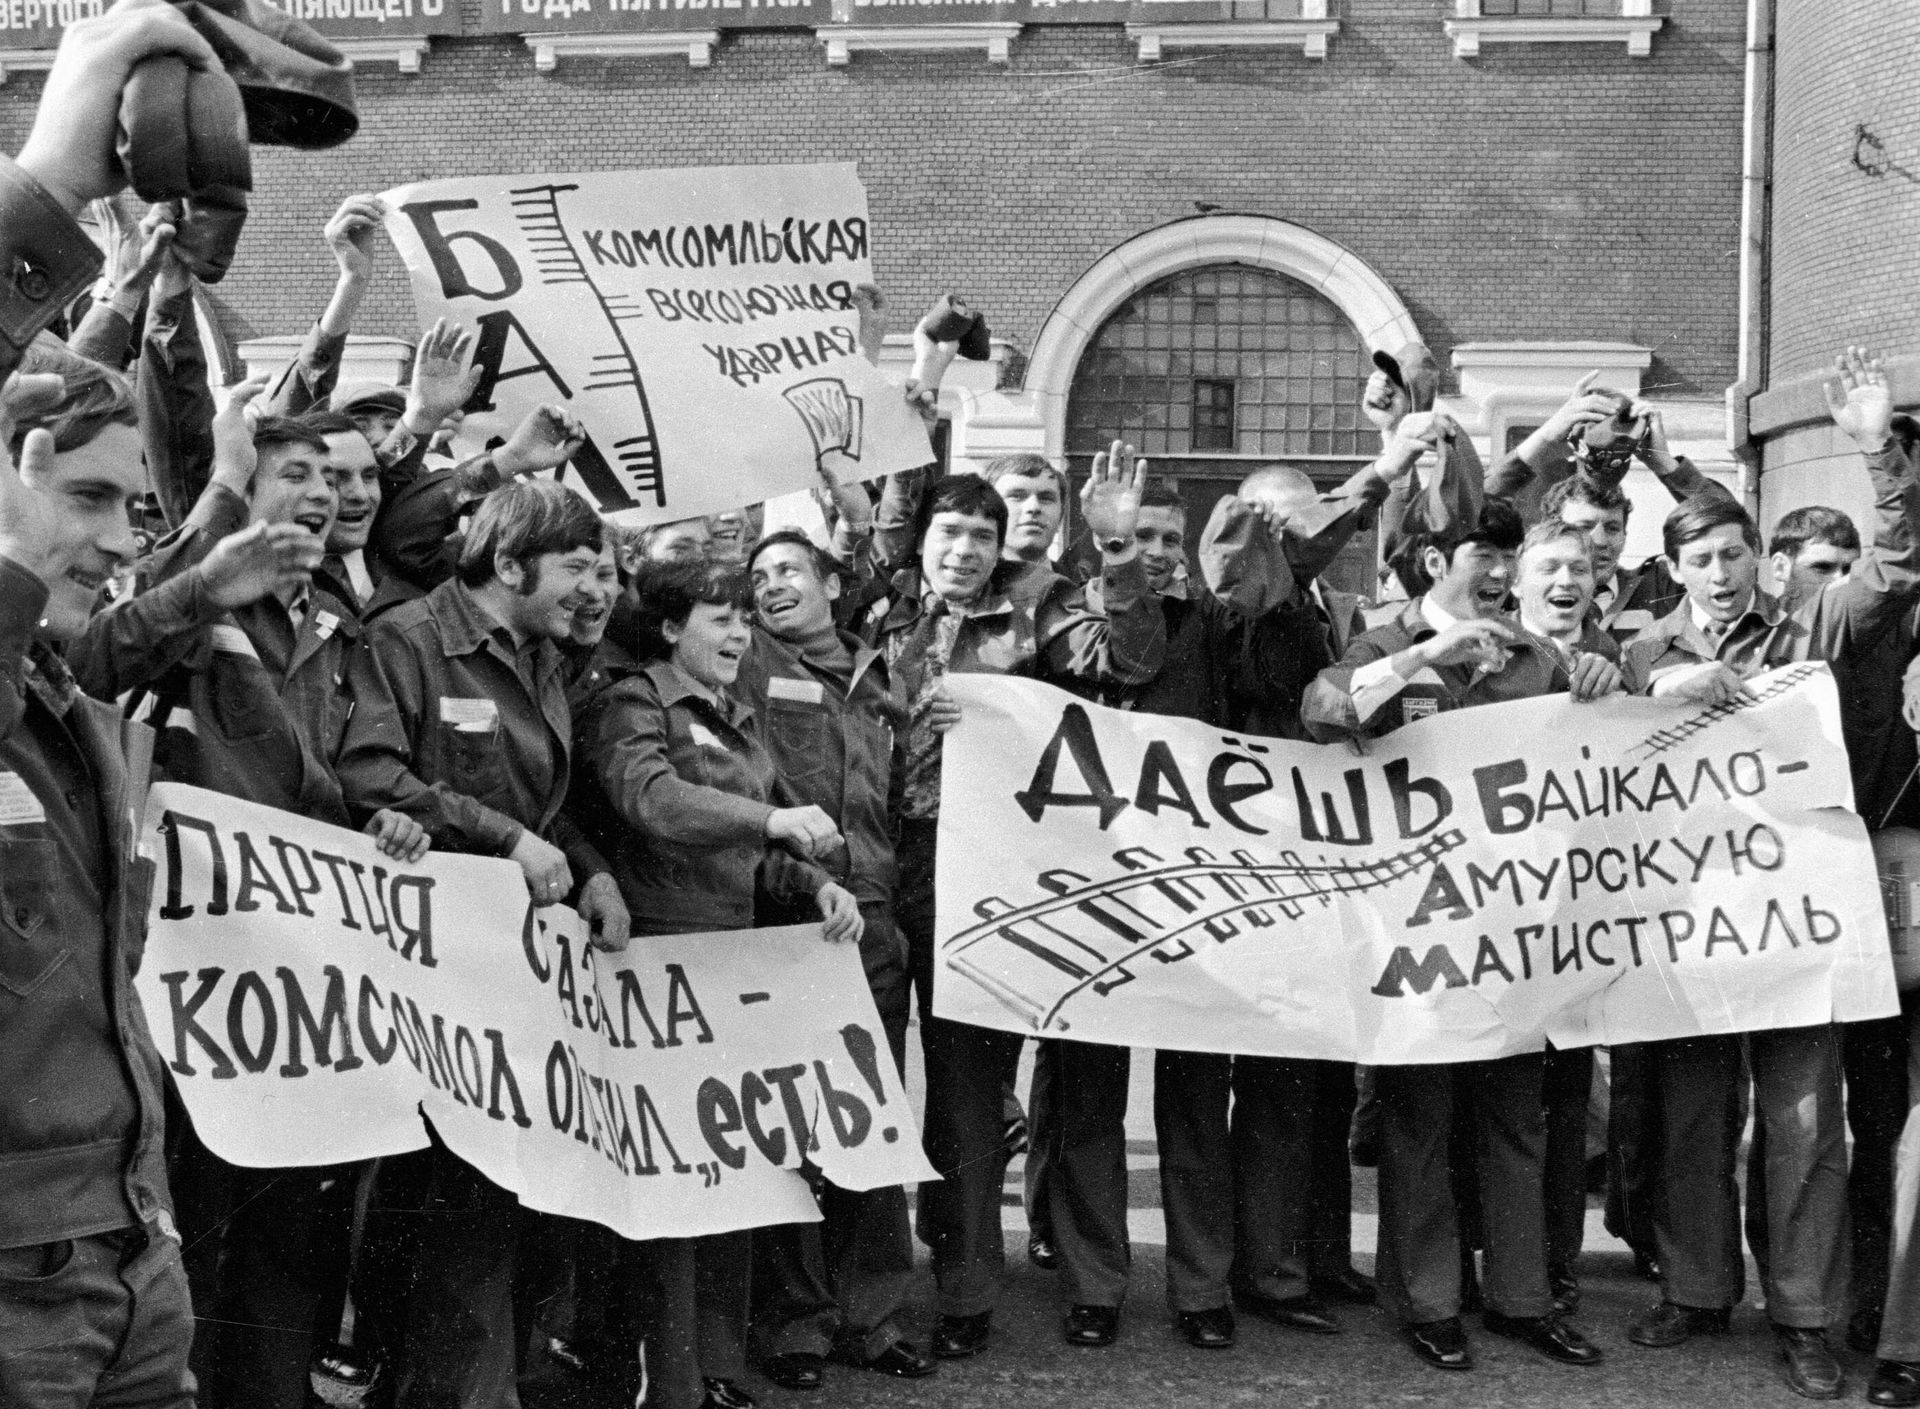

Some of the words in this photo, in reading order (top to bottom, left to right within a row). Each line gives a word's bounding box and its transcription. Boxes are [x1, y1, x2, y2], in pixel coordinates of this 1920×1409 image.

[263, 0, 444, 22] ЛЯЮЩЕГО
[158, 809, 439, 968] ПАРТИЯ
[1405, 822, 1787, 928] АМУРСКУЮ
[1370, 894, 1843, 998] МАГИСТРАЛЬ
[159, 964, 533, 1130] КОМСОМОЛ
